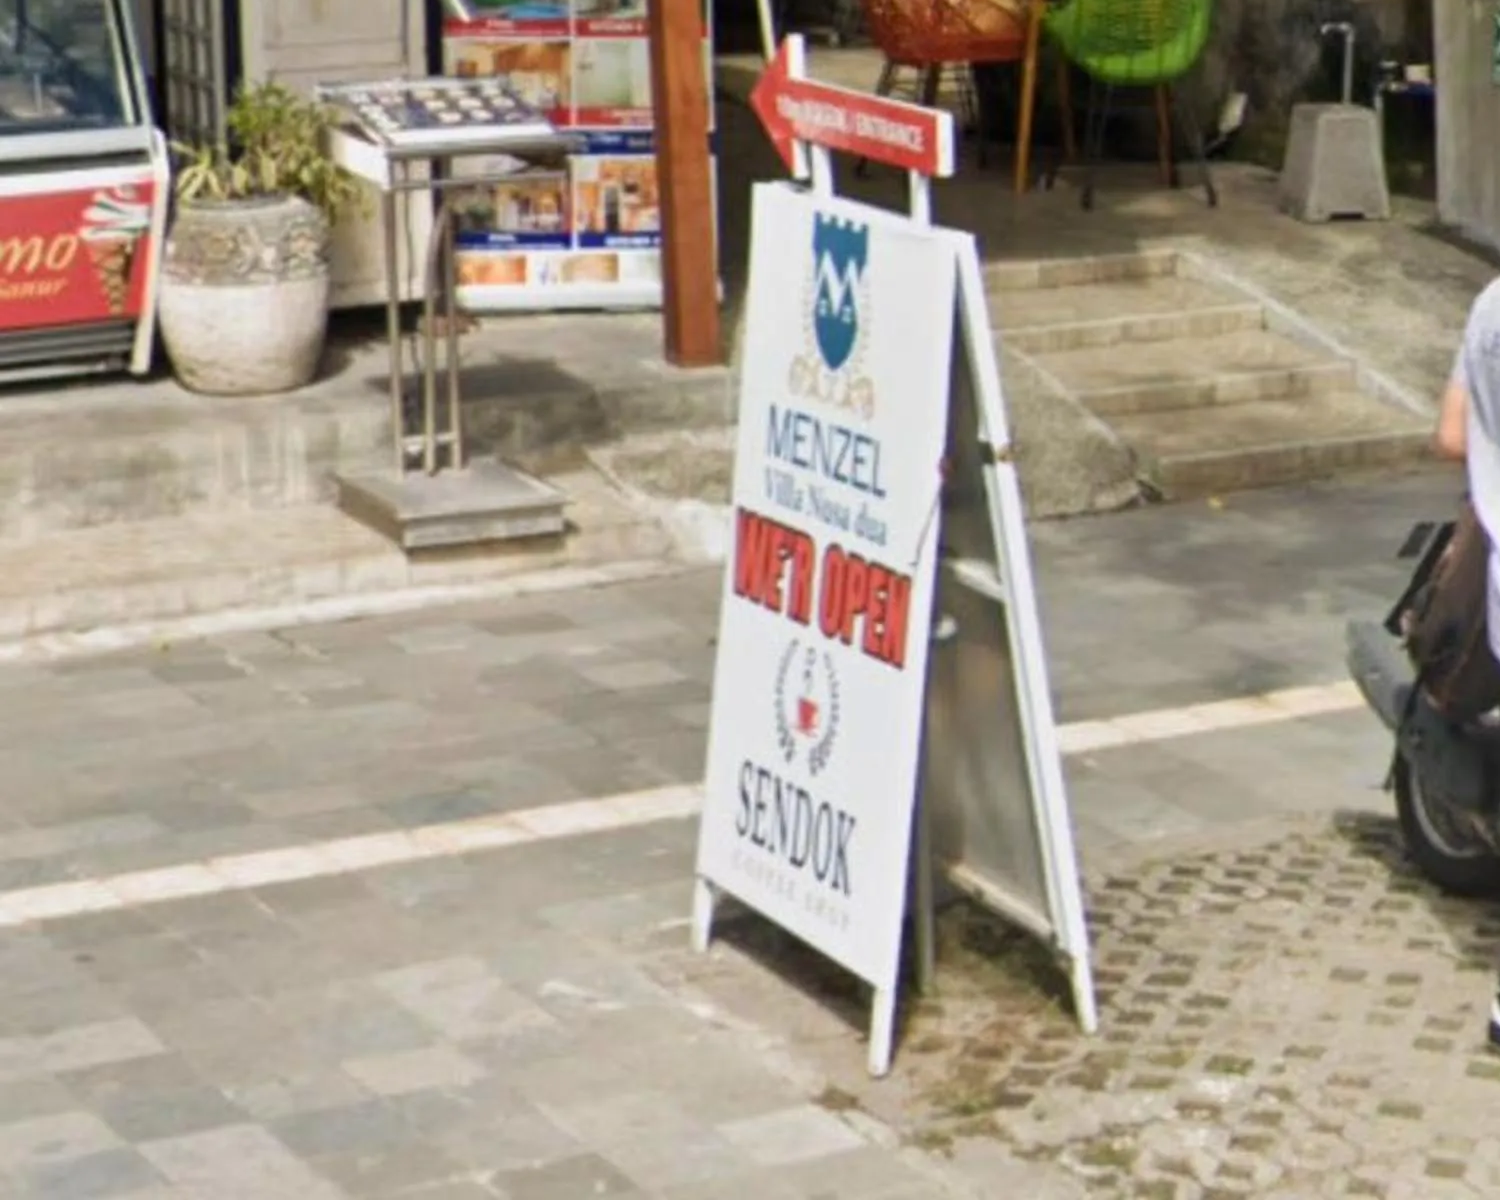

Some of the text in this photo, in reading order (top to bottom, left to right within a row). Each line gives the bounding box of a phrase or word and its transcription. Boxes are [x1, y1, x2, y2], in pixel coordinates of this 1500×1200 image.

[767, 402, 886, 498] MENZEL
[818, 541, 912, 672] OPEN
[736, 759, 857, 896] SENDOK
